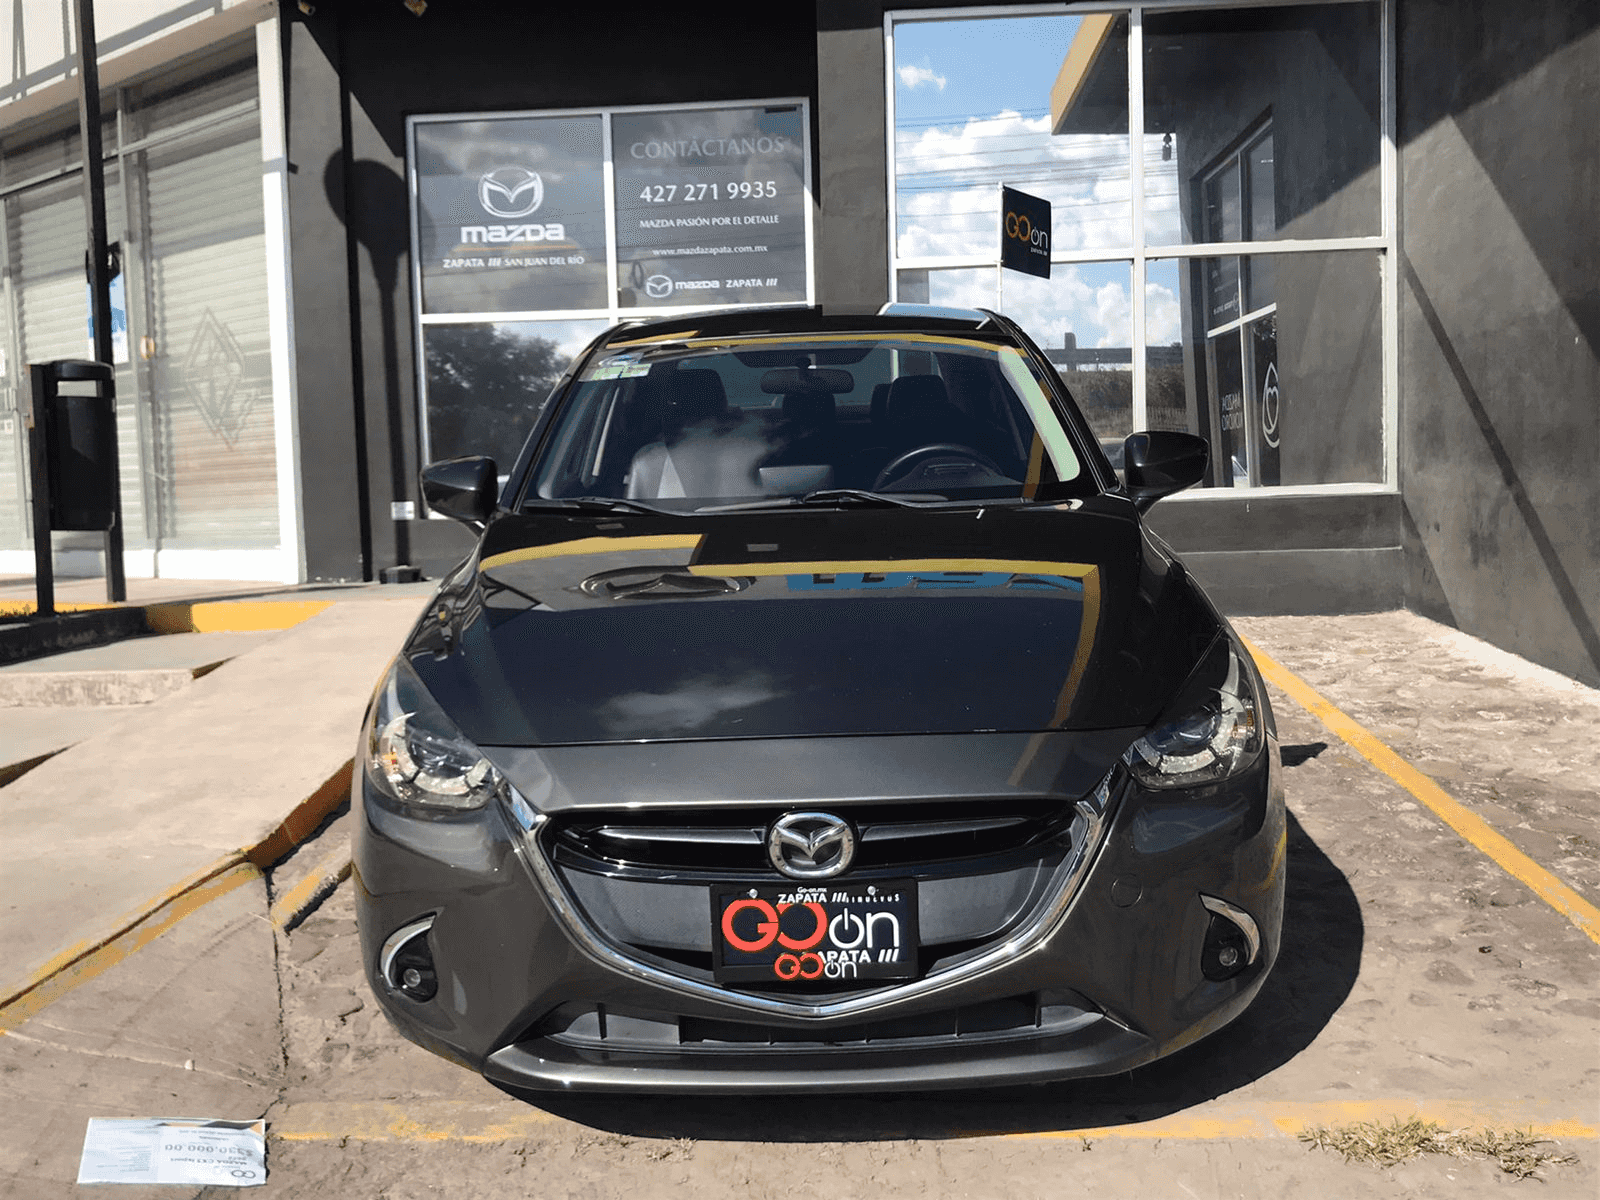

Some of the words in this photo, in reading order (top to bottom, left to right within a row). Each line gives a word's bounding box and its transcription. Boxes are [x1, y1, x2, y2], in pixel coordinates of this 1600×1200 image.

[630, 136, 785, 159] CONTÁCTANOS
[640, 184, 677, 203] 427
[684, 183, 718, 201] 271
[727, 180, 777, 199] 9935
[639, 219, 676, 229] MAZDA
[676, 216, 711, 228] PASIÓN
[711, 216, 731, 226] POR
[733, 216, 742, 225] EL
[743, 214, 780, 225] DETALLE
[460, 223, 565, 243] mazda
[652, 245, 768, 256] www.mazdazapata.com.mx
[442, 258, 485, 269] ZAPATA
[504, 257, 524, 266] SAN
[523, 256, 548, 267] JUAN
[549, 256, 566, 265] DEL
[725, 278, 764, 288] ZAPATA
[778, 893, 827, 904] ZAPATA
